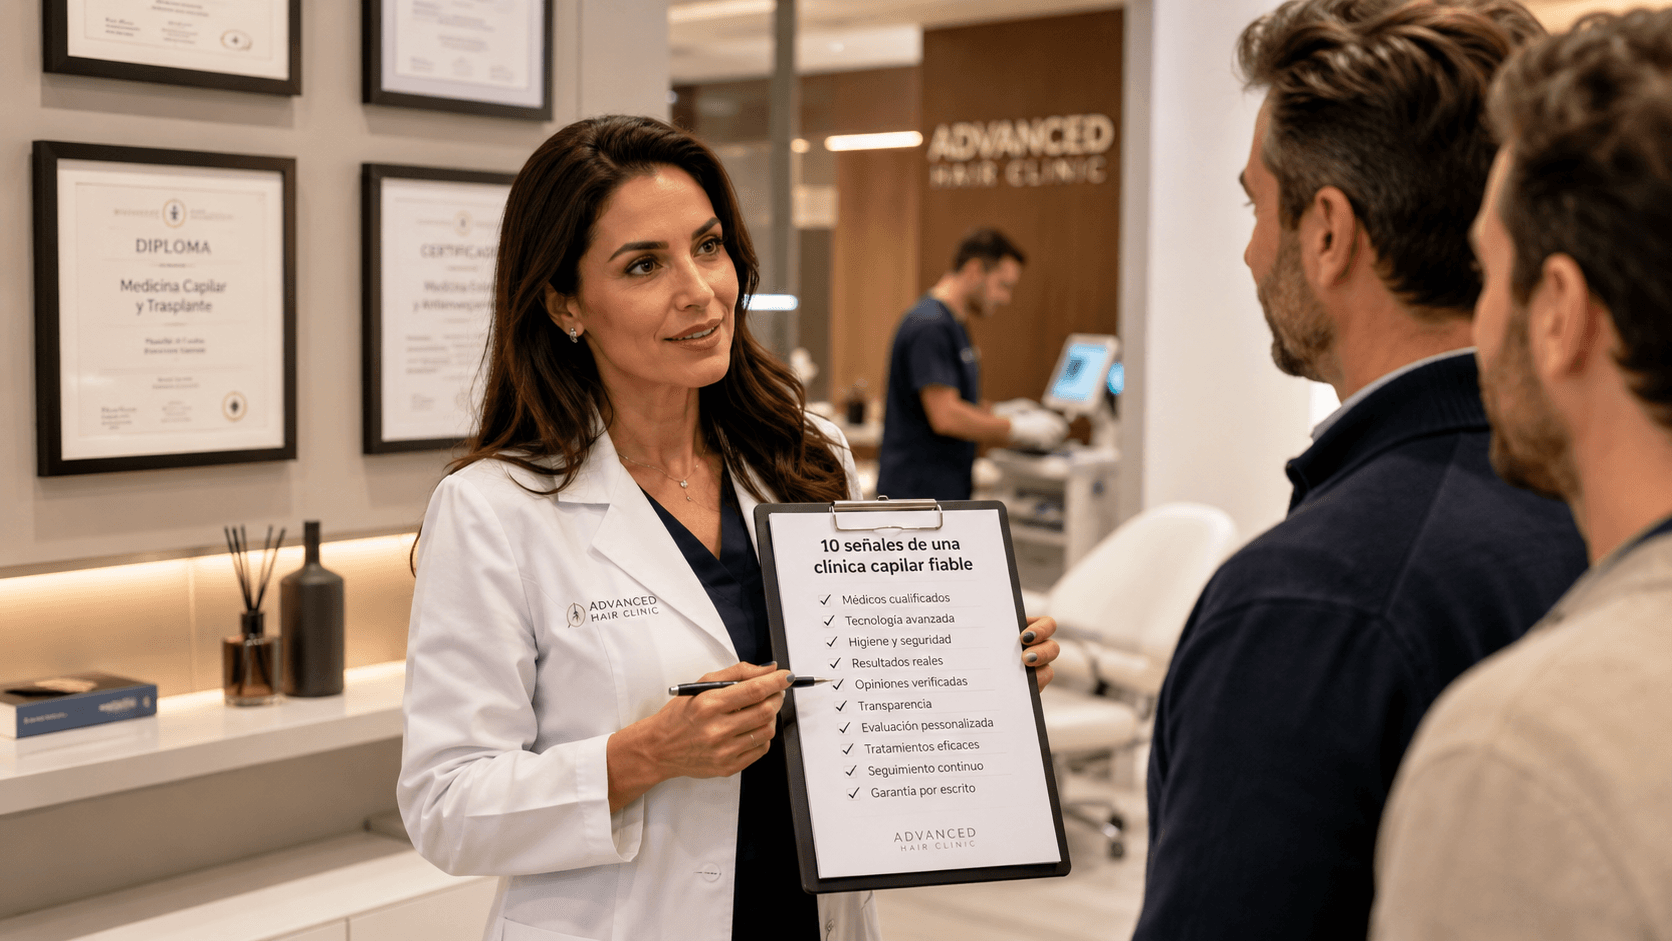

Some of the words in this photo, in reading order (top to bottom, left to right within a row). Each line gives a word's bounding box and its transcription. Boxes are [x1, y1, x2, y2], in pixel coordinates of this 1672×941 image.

[927, 113, 1115, 162] ADVANCED
[929, 160, 998, 188] HAIR
[1005, 155, 1107, 187] CLINIC
[136, 238, 212, 254] DIPLOMA
[120, 278, 179, 293] Medicina
[182, 279, 227, 296] Capilar
[135, 302, 144, 315] y
[147, 299, 212, 315] Trasplante
[820, 538, 839, 552] 10
[844, 538, 904, 552] señales
[908, 537, 927, 551] de
[932, 539, 960, 550] una
[814, 559, 866, 573] clínica
[870, 558, 924, 575] capilar
[928, 557, 973, 571] fiable
[589, 595, 657, 611] ADVANCED
[842, 594, 887, 605] Médicos
[889, 593, 951, 604] cualificados
[590, 611, 618, 622] HAIR
[622, 607, 659, 618] CLINIC
[905, 613, 955, 624] avanzada
[848, 636, 889, 649] Higiene
[891, 638, 898, 648] y
[900, 634, 952, 648] seguridad
[851, 657, 910, 668] Resultados
[912, 656, 944, 666] reales
[854, 678, 909, 692] Opiniones
[911, 676, 968, 688] verificadas
[858, 699, 933, 713] Transparencia
[861, 720, 918, 733] Evaluación
[864, 742, 935, 754] Tratamientos
[937, 740, 980, 751] eficaces
[867, 763, 935, 778] Seguimiento
[938, 761, 984, 773] continuo
[919, 786, 937, 797] por
[940, 783, 976, 795] escrito
[893, 827, 976, 843] ADVANCED
[900, 843, 928, 852] HAIR
[935, 840, 976, 850] CLINIC
